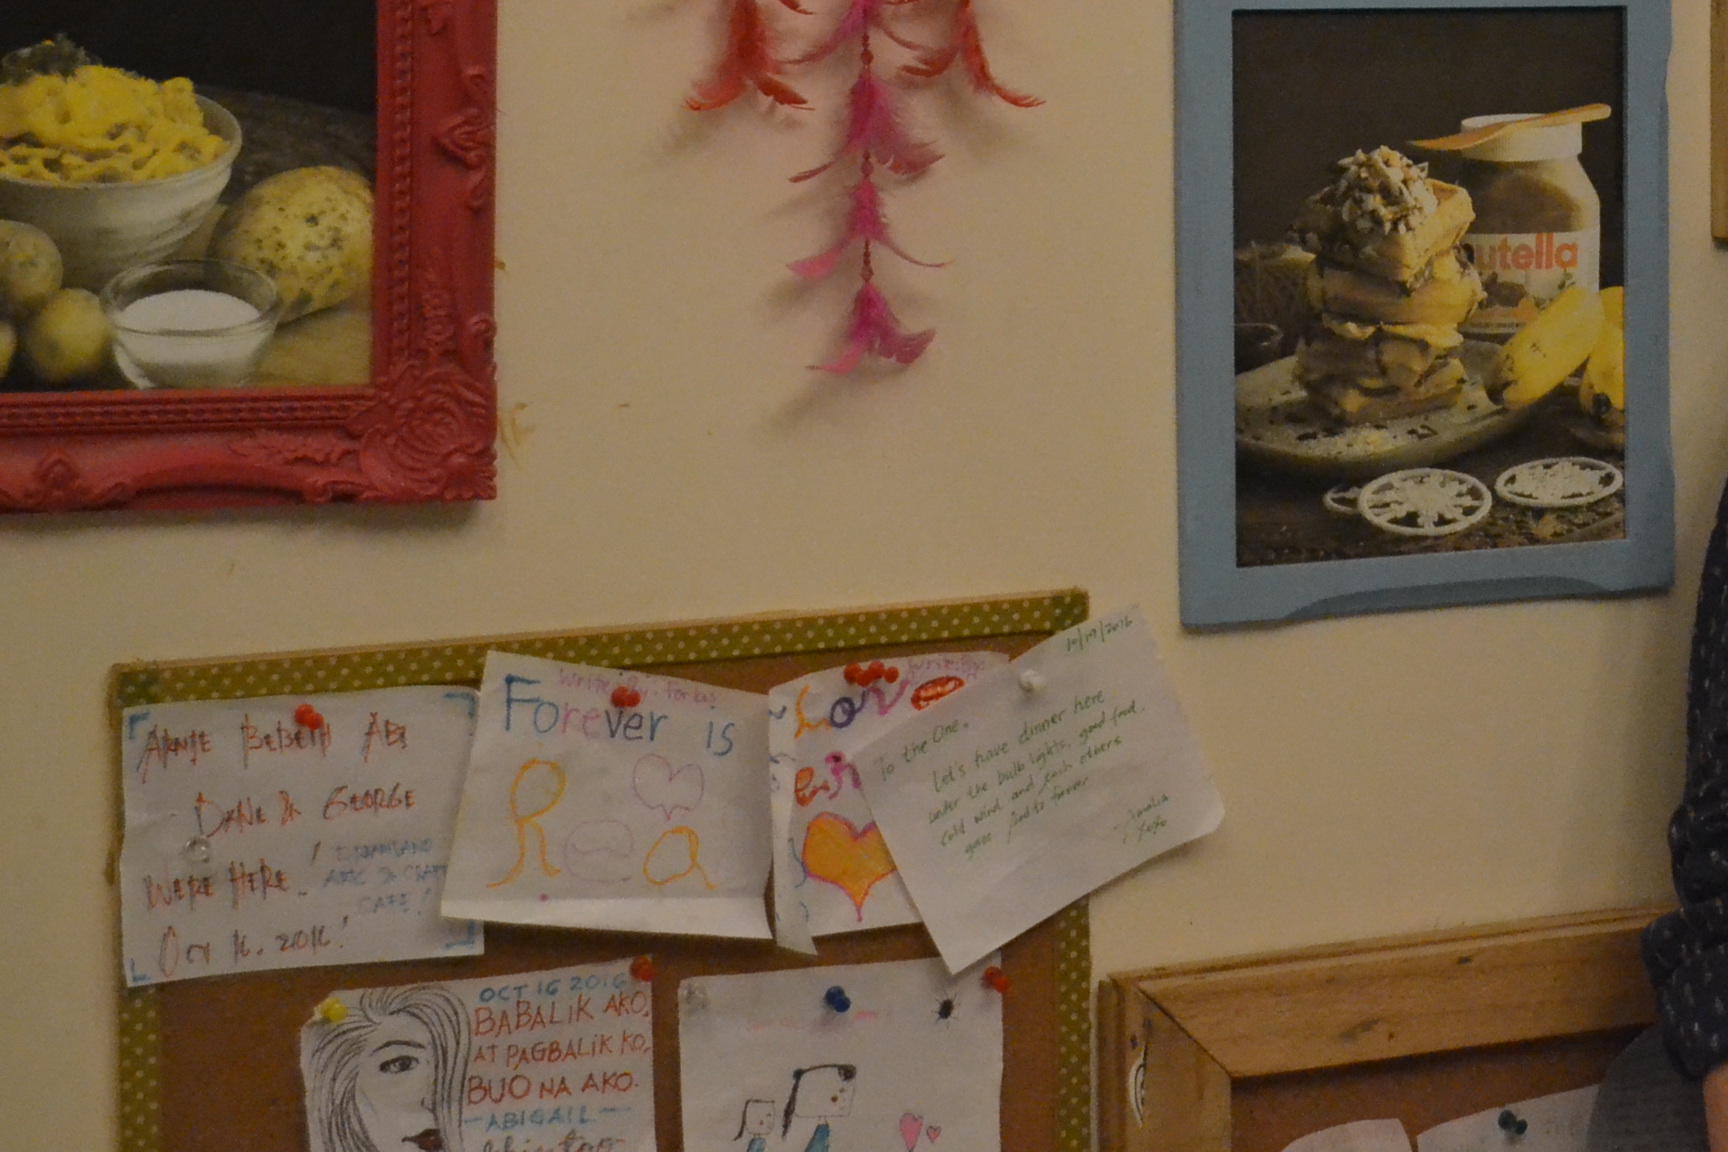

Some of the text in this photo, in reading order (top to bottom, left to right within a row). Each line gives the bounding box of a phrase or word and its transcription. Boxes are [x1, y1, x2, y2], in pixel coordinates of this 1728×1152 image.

[1464, 233, 1578, 270] utella
[505, 673, 736, 757] Forever is
[974, 742, 1010, 768] have
[1018, 710, 1067, 744] dinner
[479, 972, 628, 1003] OCT 16 2016
[473, 1044, 498, 1063] AT
[467, 1074, 531, 1106] BUO
[539, 1076, 572, 1099] NA
